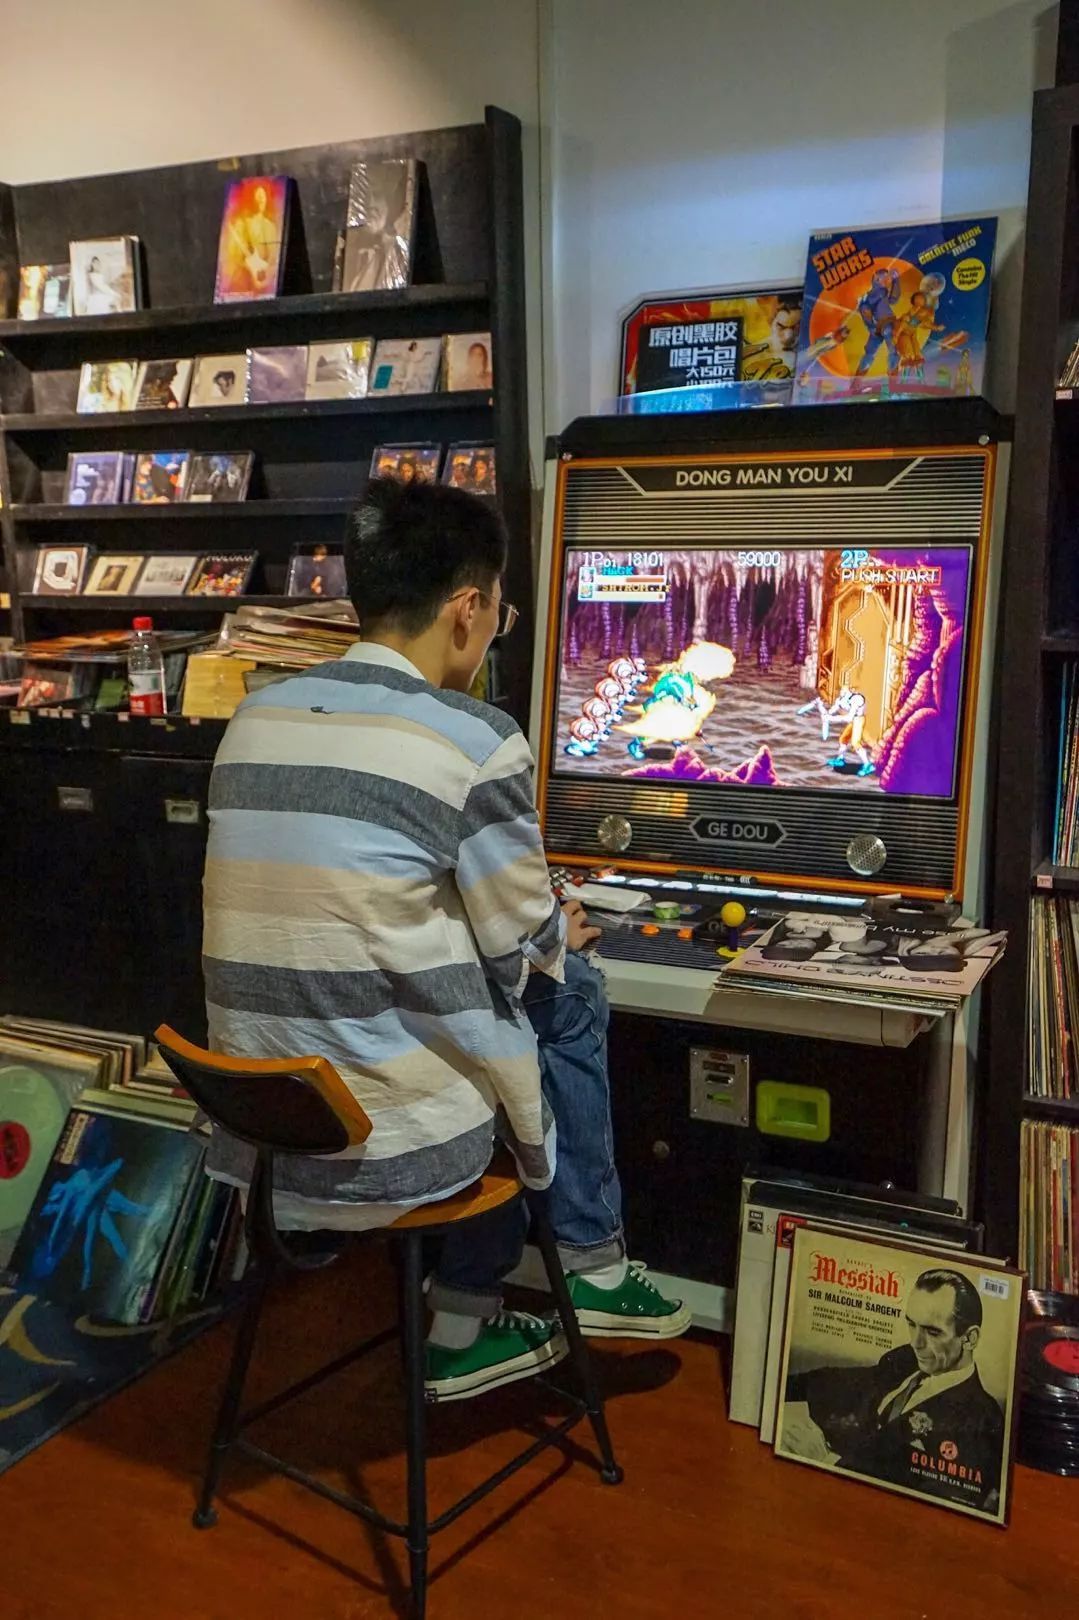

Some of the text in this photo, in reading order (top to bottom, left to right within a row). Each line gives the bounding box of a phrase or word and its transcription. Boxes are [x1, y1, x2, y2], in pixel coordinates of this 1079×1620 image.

[812, 236, 857, 273] STAR
[820, 248, 873, 290] WARS
[648, 321, 738, 347] 原创黑胶
[669, 345, 737, 368] 唱片包
[685, 363, 736, 378] 大150元
[676, 465, 853, 487] DONG MAN YOU XI
[738, 551, 781, 567] 59000
[842, 568, 940, 584] PUSH START
[708, 822, 768, 840] GE DOU
[809, 1253, 899, 1298] Messiah
[808, 1288, 822, 1299] SIR
[825, 1292, 863, 1308] MALCOLM
[865, 1302, 902, 1318] SARGENT
[911, 1451, 982, 1484] COLUMBIA
